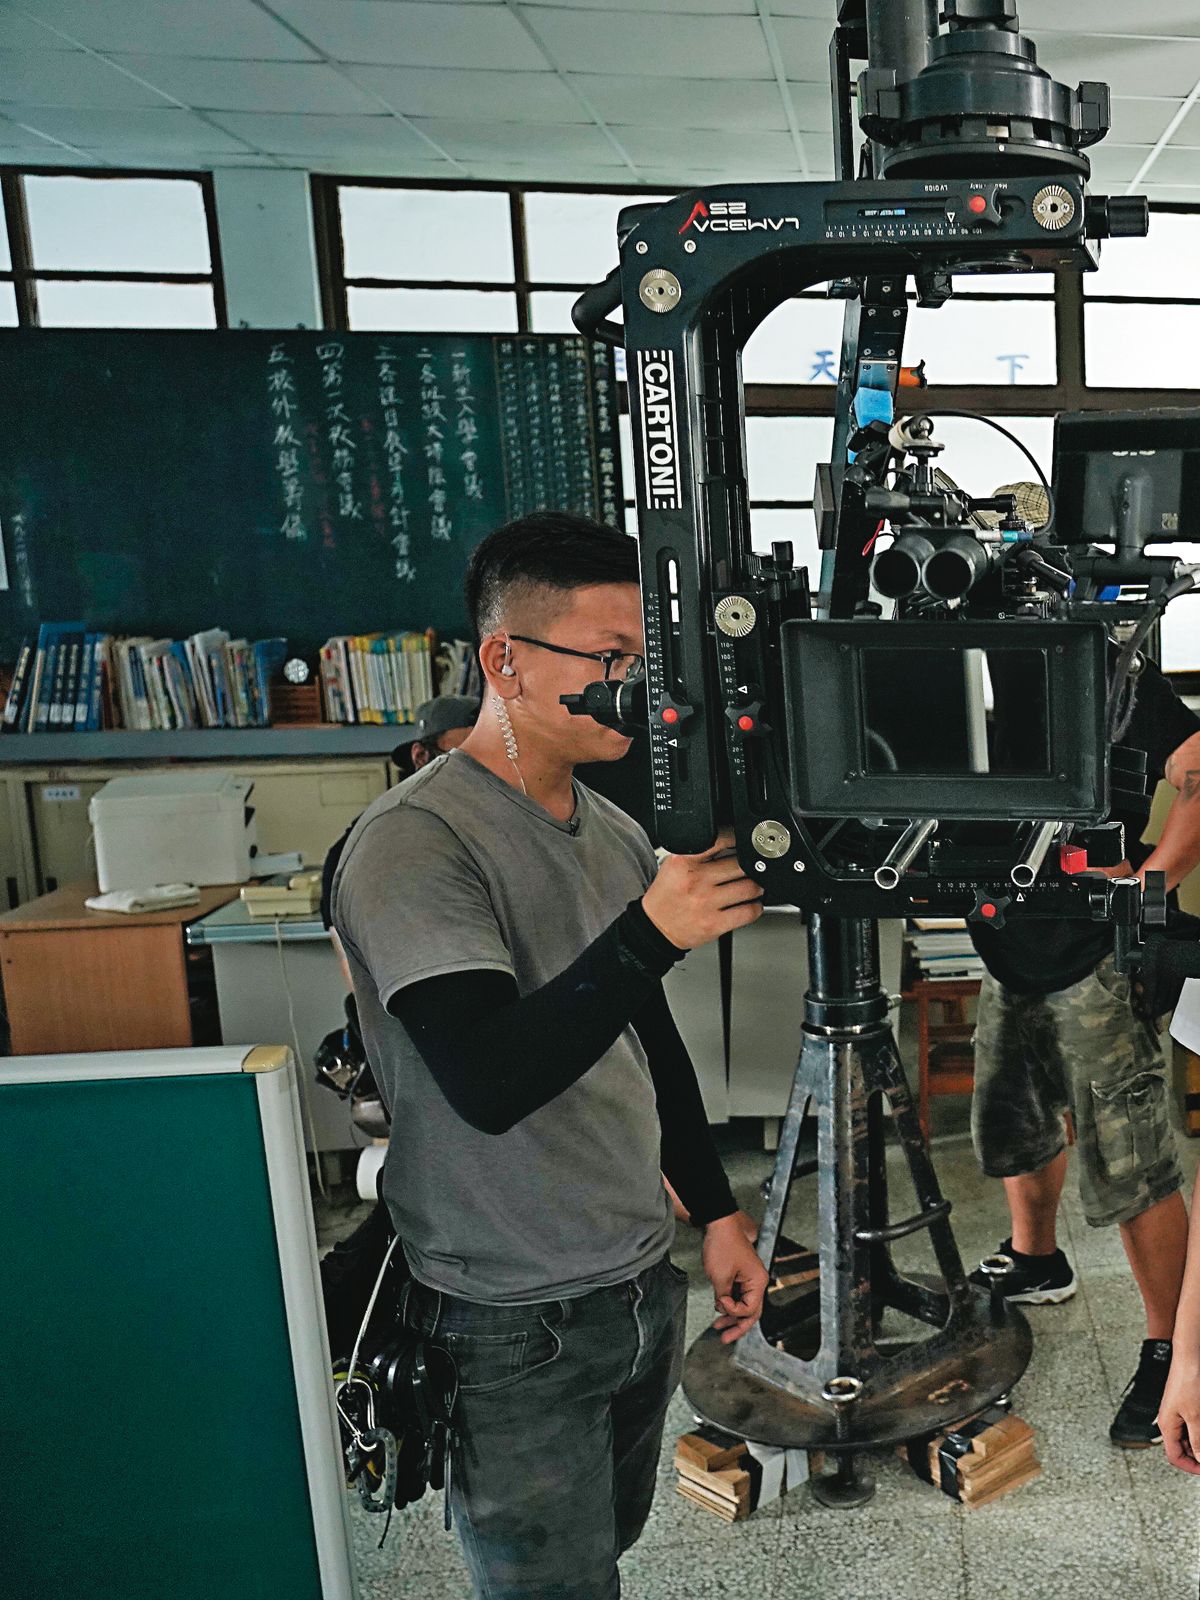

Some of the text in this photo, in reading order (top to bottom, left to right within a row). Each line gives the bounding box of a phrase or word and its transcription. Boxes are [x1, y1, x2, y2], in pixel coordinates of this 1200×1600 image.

[709, 202, 746, 215] 25
[692, 217, 800, 233] LAMBDA
[644, 362, 675, 495] CARTONI
